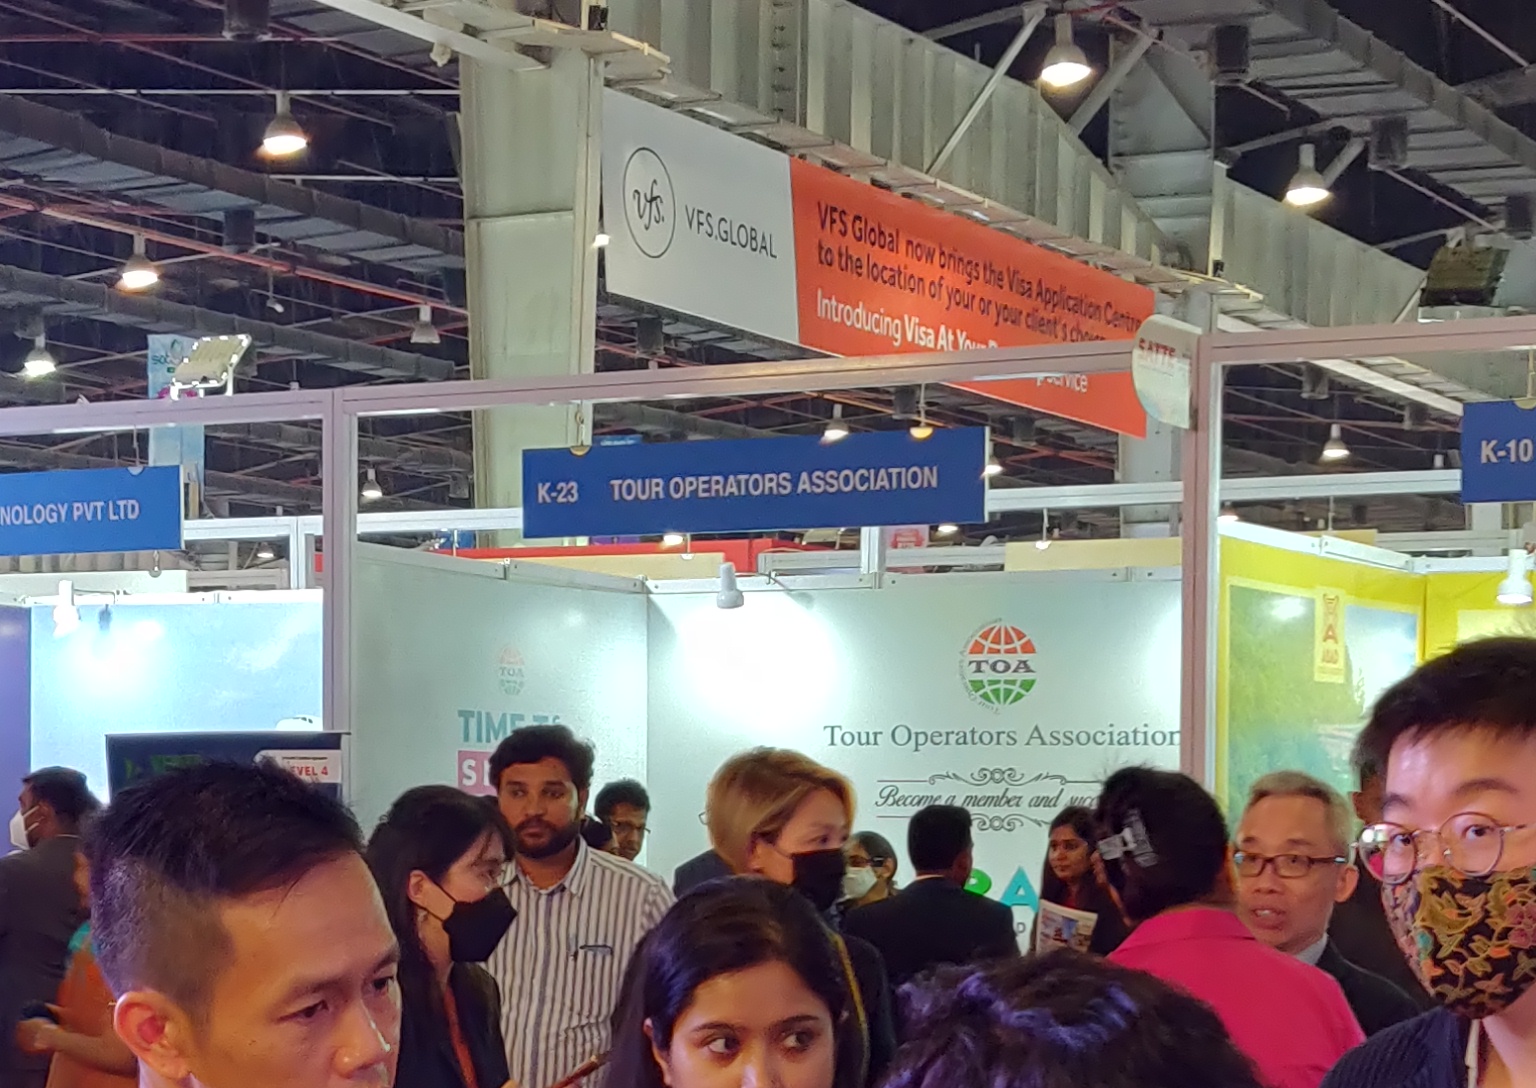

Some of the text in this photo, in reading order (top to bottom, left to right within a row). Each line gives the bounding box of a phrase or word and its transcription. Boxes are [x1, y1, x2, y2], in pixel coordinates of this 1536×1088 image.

[817, 201, 847, 237] VFS
[852, 214, 899, 254] Global
[905, 238, 936, 264] now
[939, 243, 980, 285] brings
[983, 263, 1004, 290] the
[1007, 267, 1032, 298] Visa
[1036, 278, 1102, 321] Application
[818, 240, 834, 266] to
[838, 246, 863, 277] the
[867, 253, 925, 296] location
[929, 276, 944, 299] of
[945, 289, 975, 311] your
[979, 296, 991, 315] or
[994, 302, 1022, 326] your
[817, 288, 902, 347] Introducing
[904, 314, 935, 348] Visa
[937, 325, 954, 351] At
[1481, 438, 1533, 464] K-10
[537, 465, 938, 503] K-23 TOUR OPERATORS ASSOCIATION
[72, 500, 103, 522] PVT
[108, 499, 140, 521] LTD
[967, 659, 1037, 674] TOA
[823, 725, 882, 747] Tour
[891, 725, 1017, 752] Operators
[875, 785, 943, 807] Become
[962, 787, 1022, 807] member
[1028, 787, 1064, 807] and
